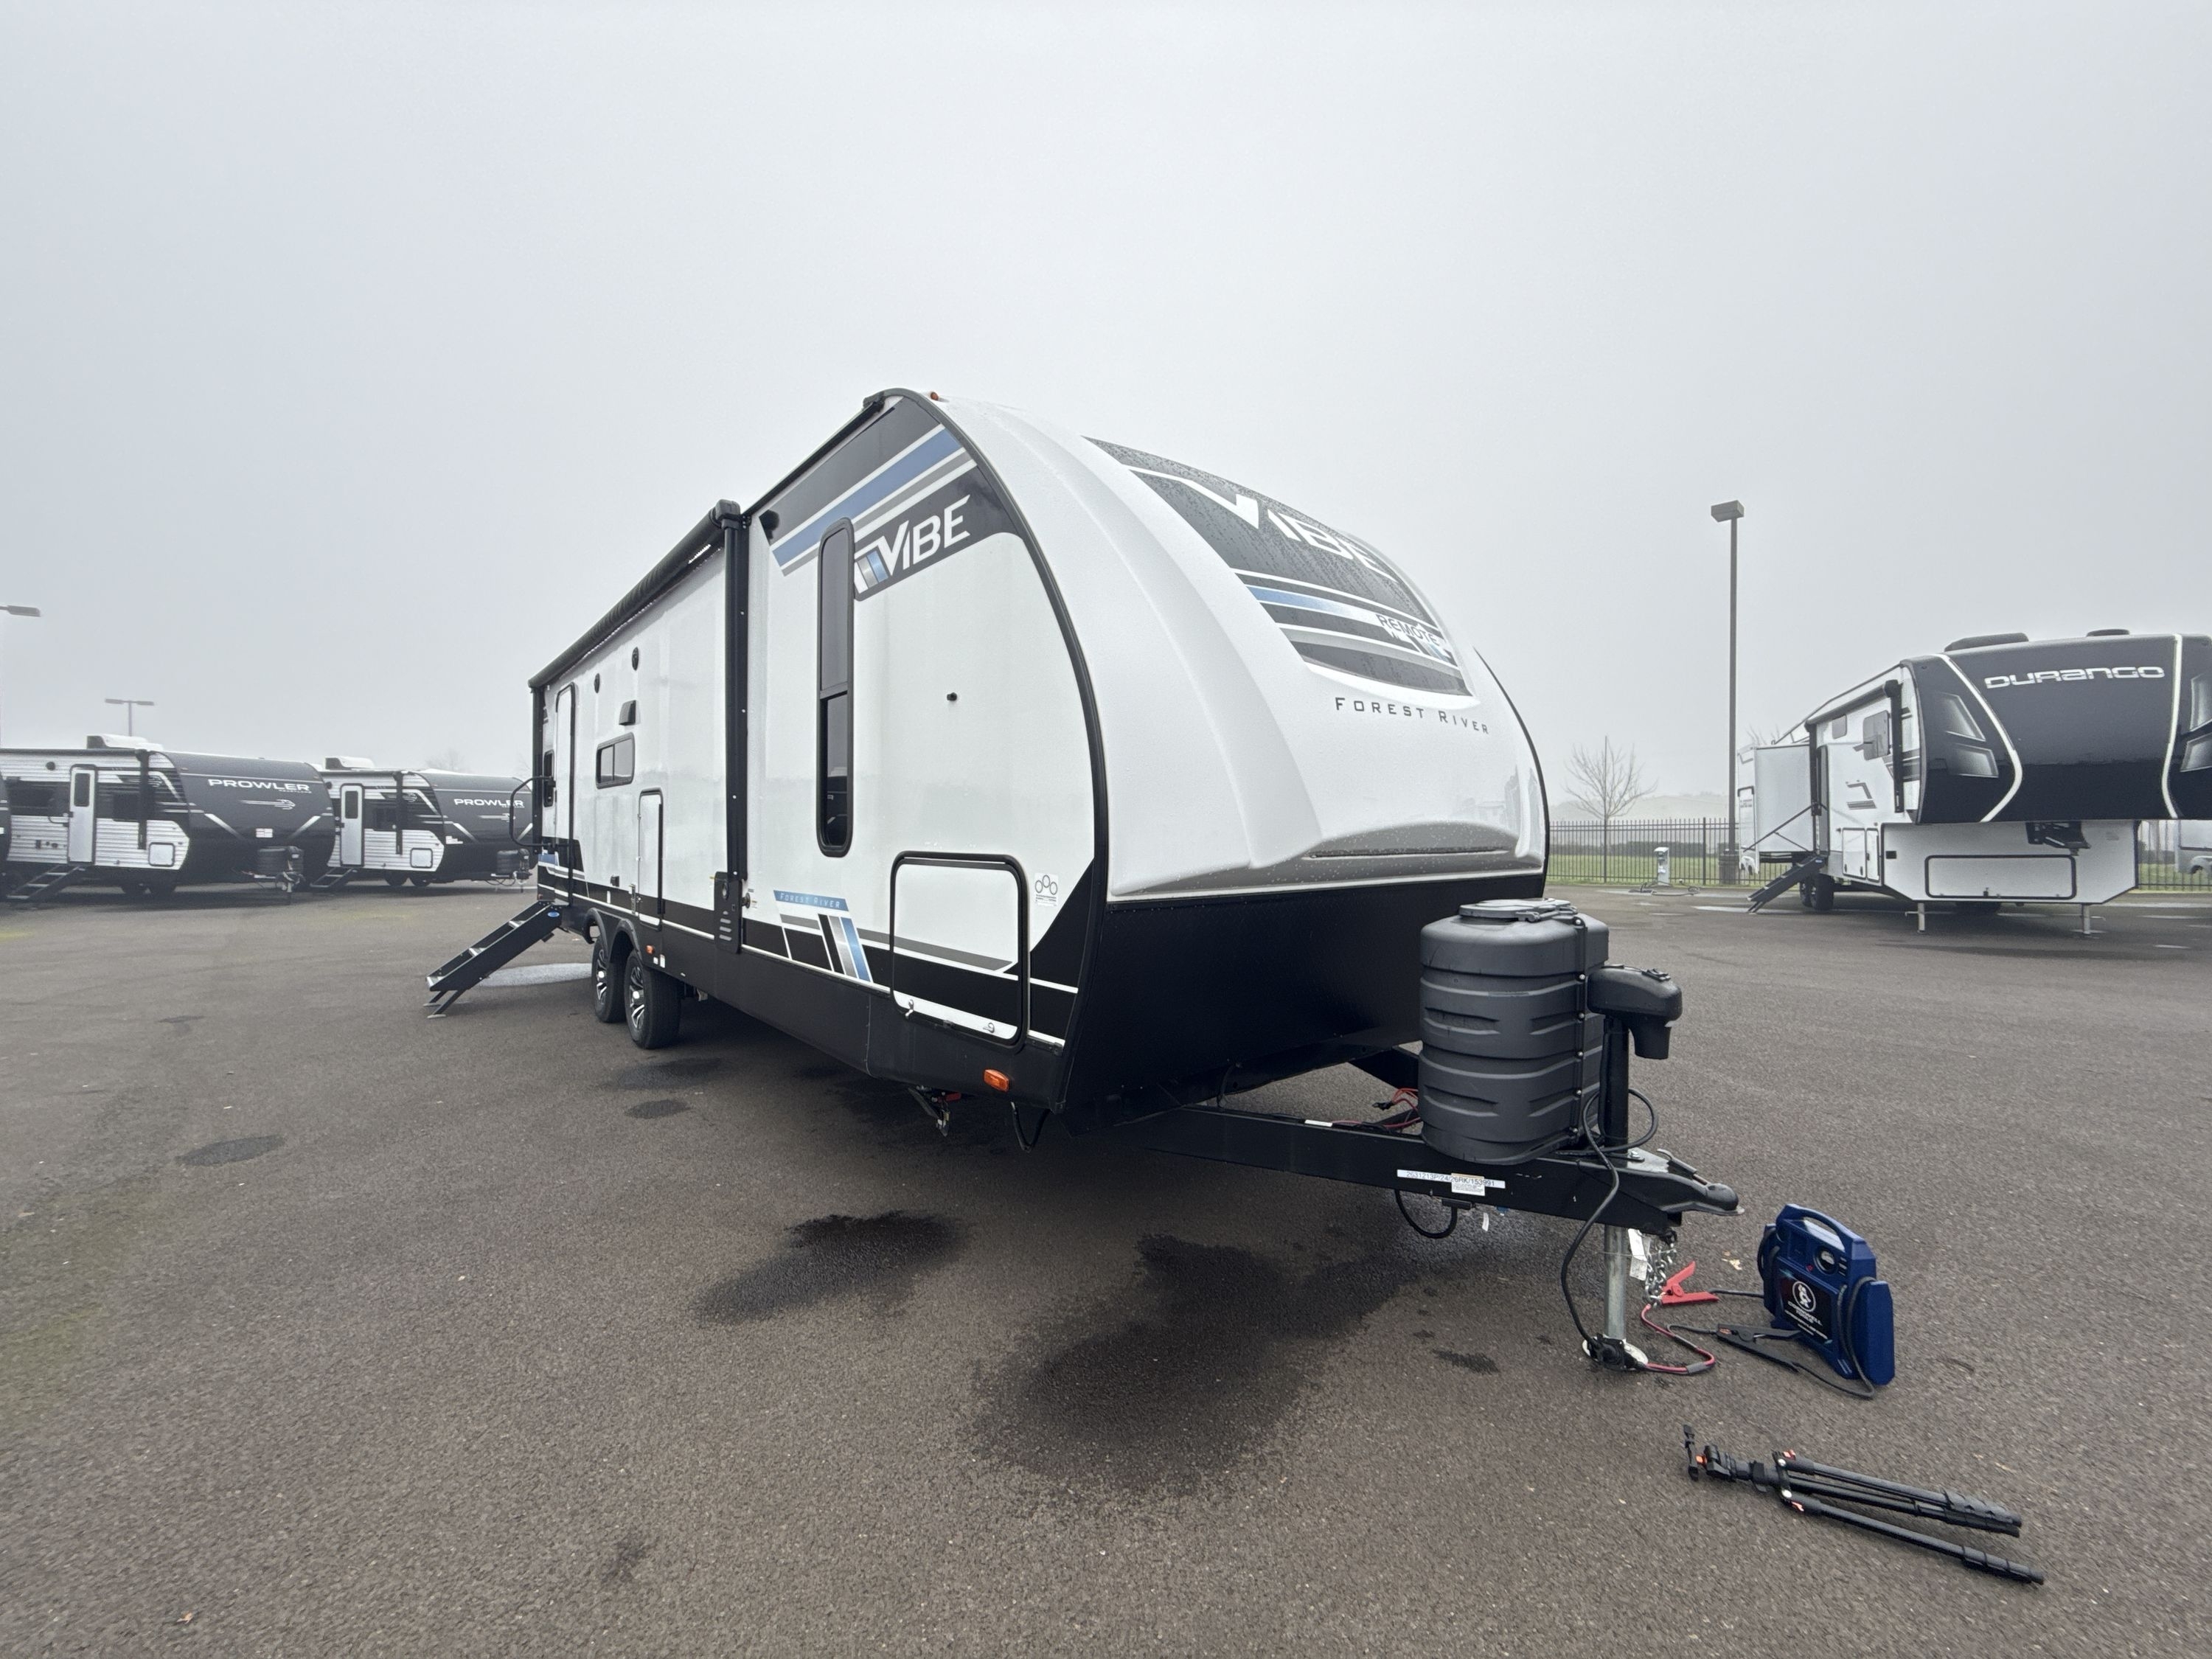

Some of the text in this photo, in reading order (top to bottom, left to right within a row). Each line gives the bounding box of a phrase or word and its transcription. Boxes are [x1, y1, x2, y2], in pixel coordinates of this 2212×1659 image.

[876, 494, 971, 577] VIBE
[1178, 476, 1399, 583] VIBE
[1376, 613, 1440, 647] REMOTE
[1984, 666, 2166, 689] DURANGO
[1335, 697, 1489, 734] FOREST RIVER
[207, 779, 310, 791] PROWLER
[780, 892, 841, 908] FOREST RIVER
